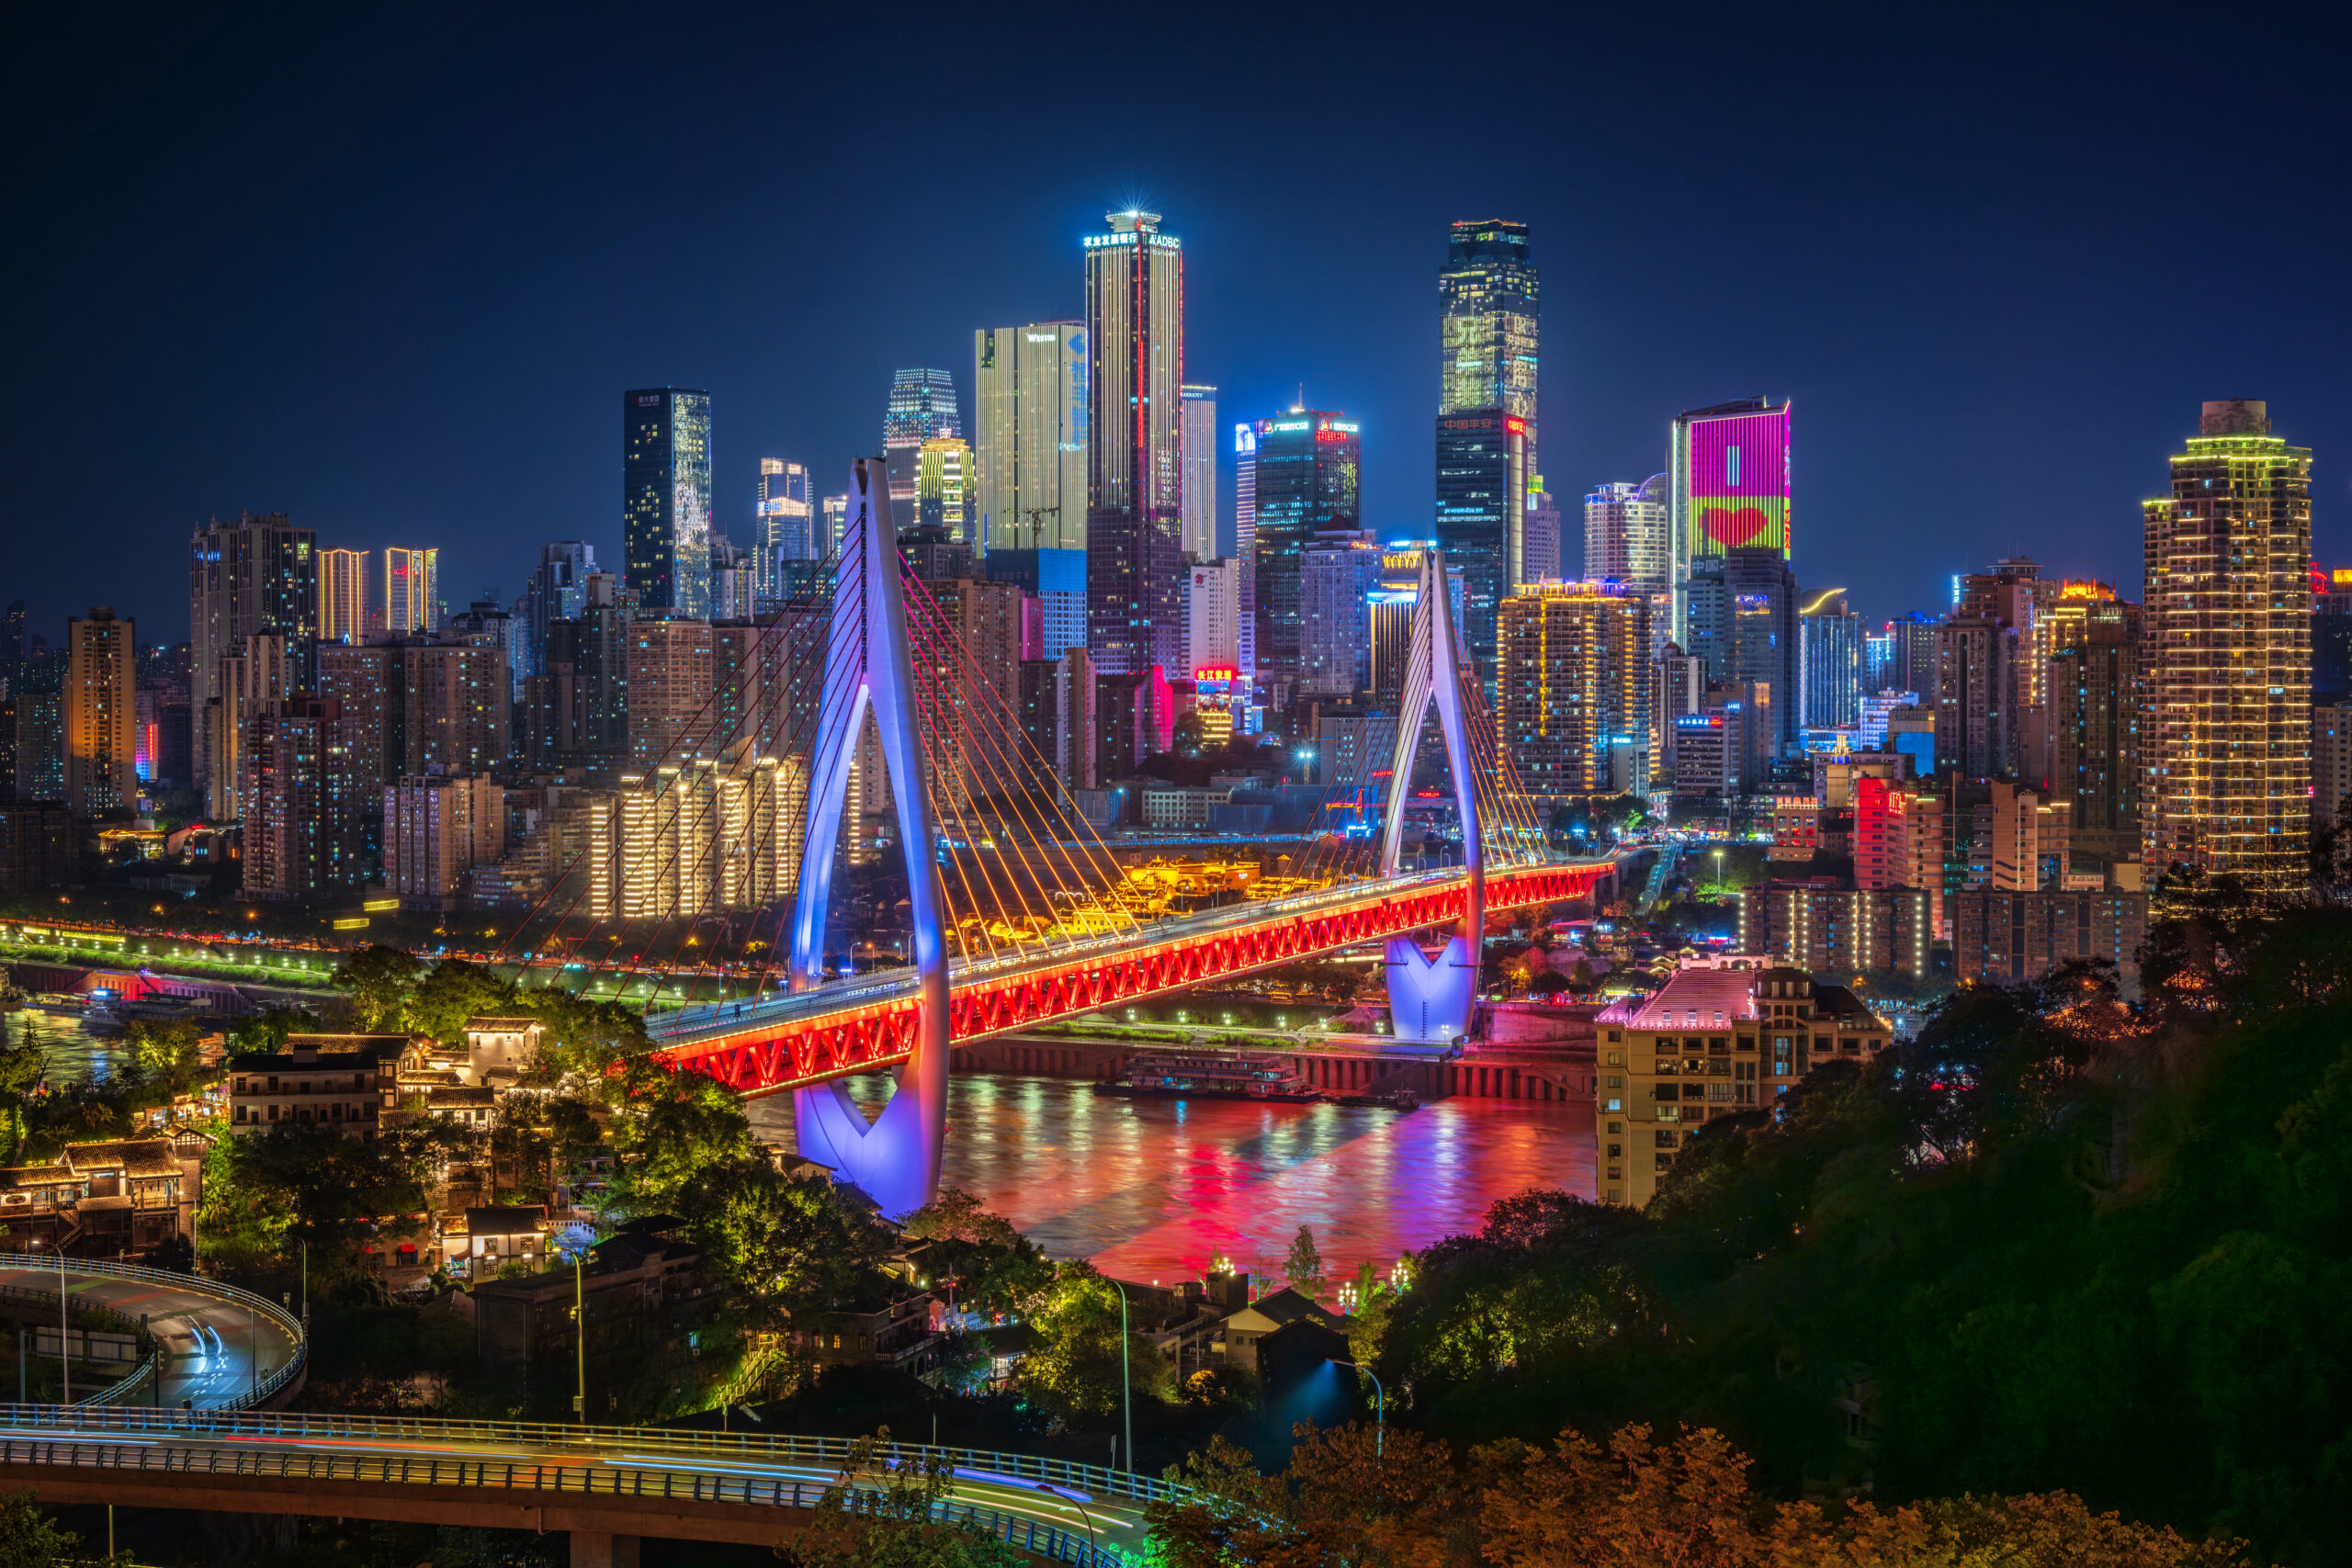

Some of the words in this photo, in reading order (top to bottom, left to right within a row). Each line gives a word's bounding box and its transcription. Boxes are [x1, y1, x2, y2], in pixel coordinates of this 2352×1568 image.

[1444, 418, 1493, 430] 中国平安
[1691, 559, 1724, 573] 中国
